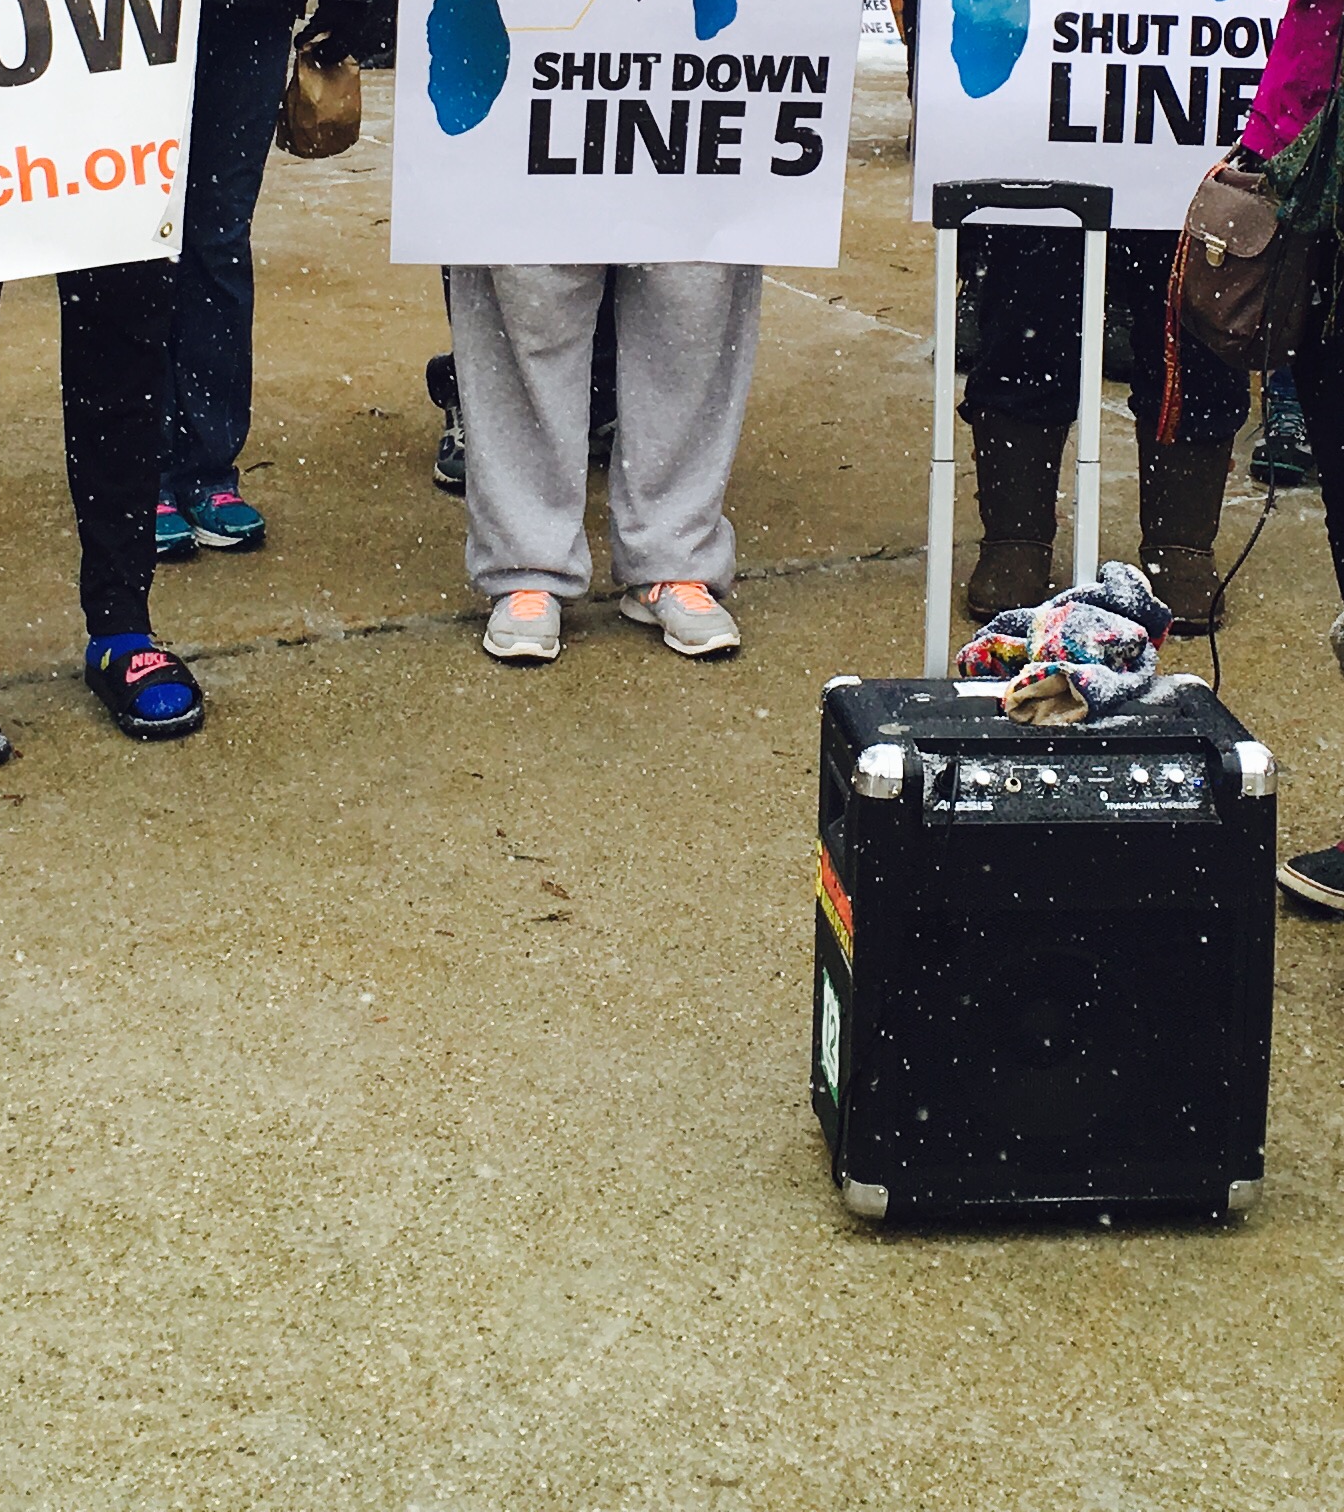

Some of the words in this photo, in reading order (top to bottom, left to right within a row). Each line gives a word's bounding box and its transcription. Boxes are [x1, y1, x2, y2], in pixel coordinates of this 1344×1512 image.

[885, 23, 894, 33] 5
[1053, 13, 1178, 56] SHUT
[532, 53, 661, 91] SHUT
[671, 55, 829, 93] DOWN
[1047, 62, 1265, 147] LINE
[527, 99, 746, 175] LINE
[770, 101, 823, 176] 5
[132, 652, 167, 670] NIKE
